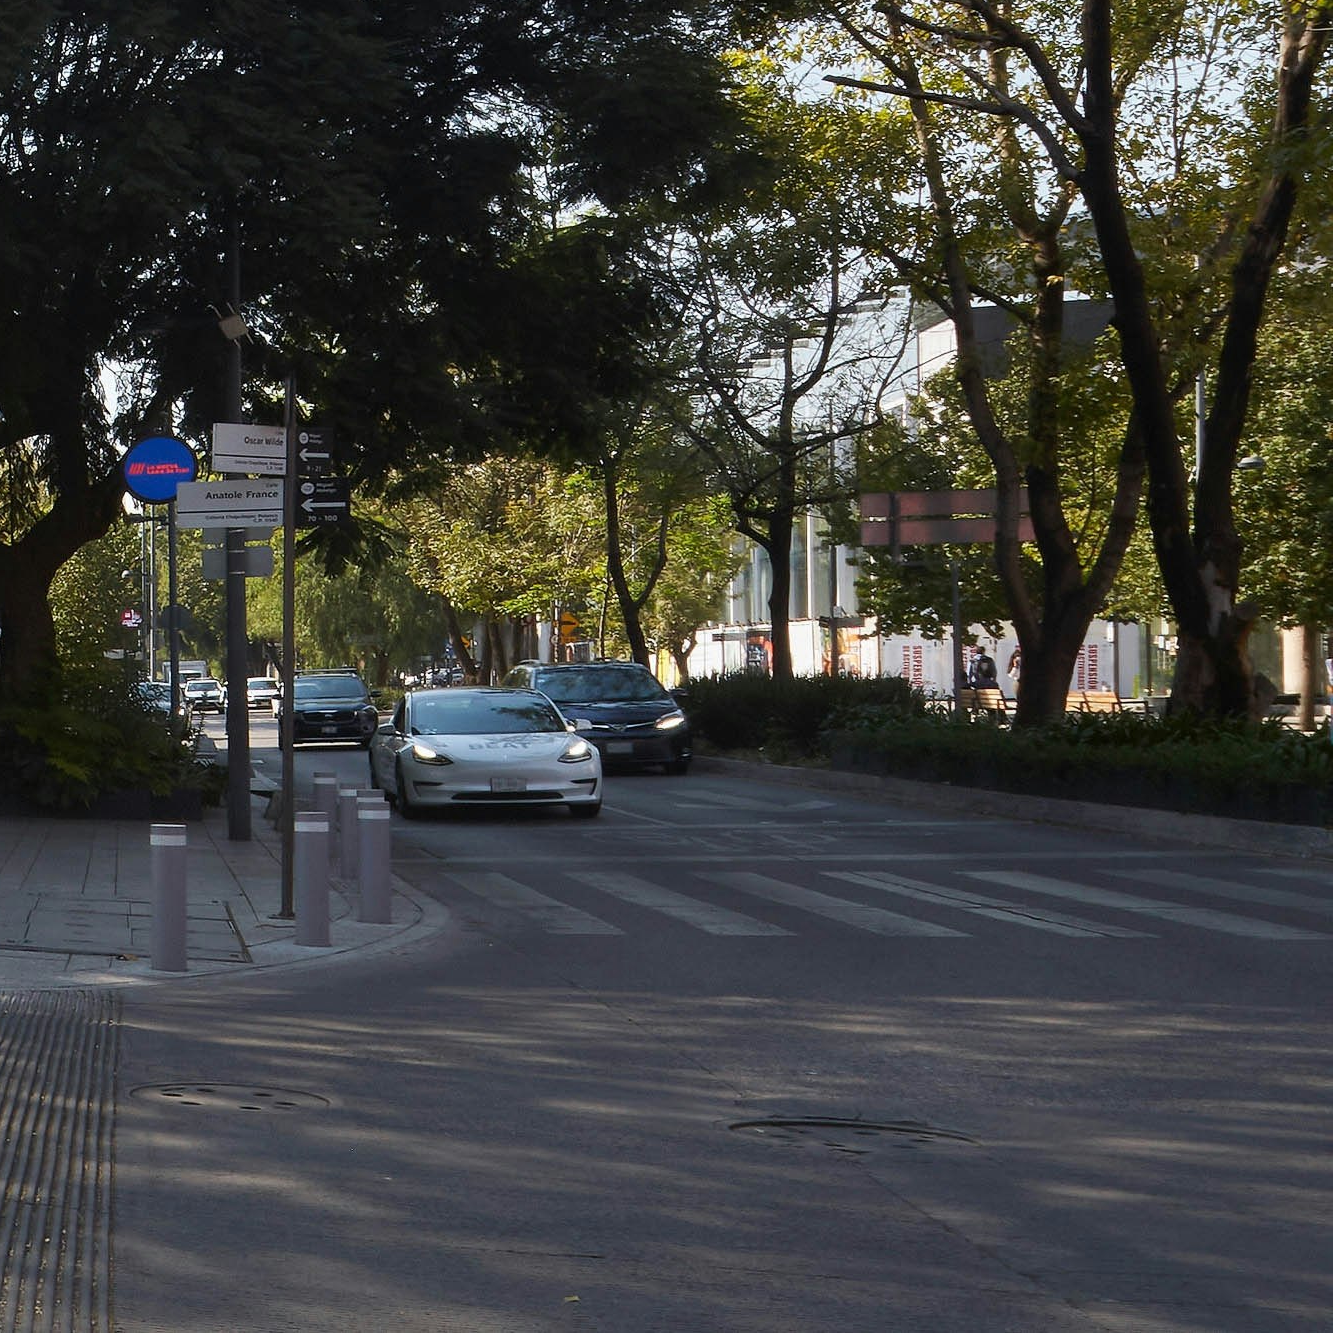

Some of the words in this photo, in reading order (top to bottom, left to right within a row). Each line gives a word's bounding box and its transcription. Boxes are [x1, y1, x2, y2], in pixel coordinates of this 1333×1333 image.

[244, 436, 264, 444] Oscar
[265, 437, 284, 446] Wilde
[205, 491, 243, 499] Anatole
[246, 490, 279, 498] France
[1088, 644, 1098, 690] SUSPENSIÓN
